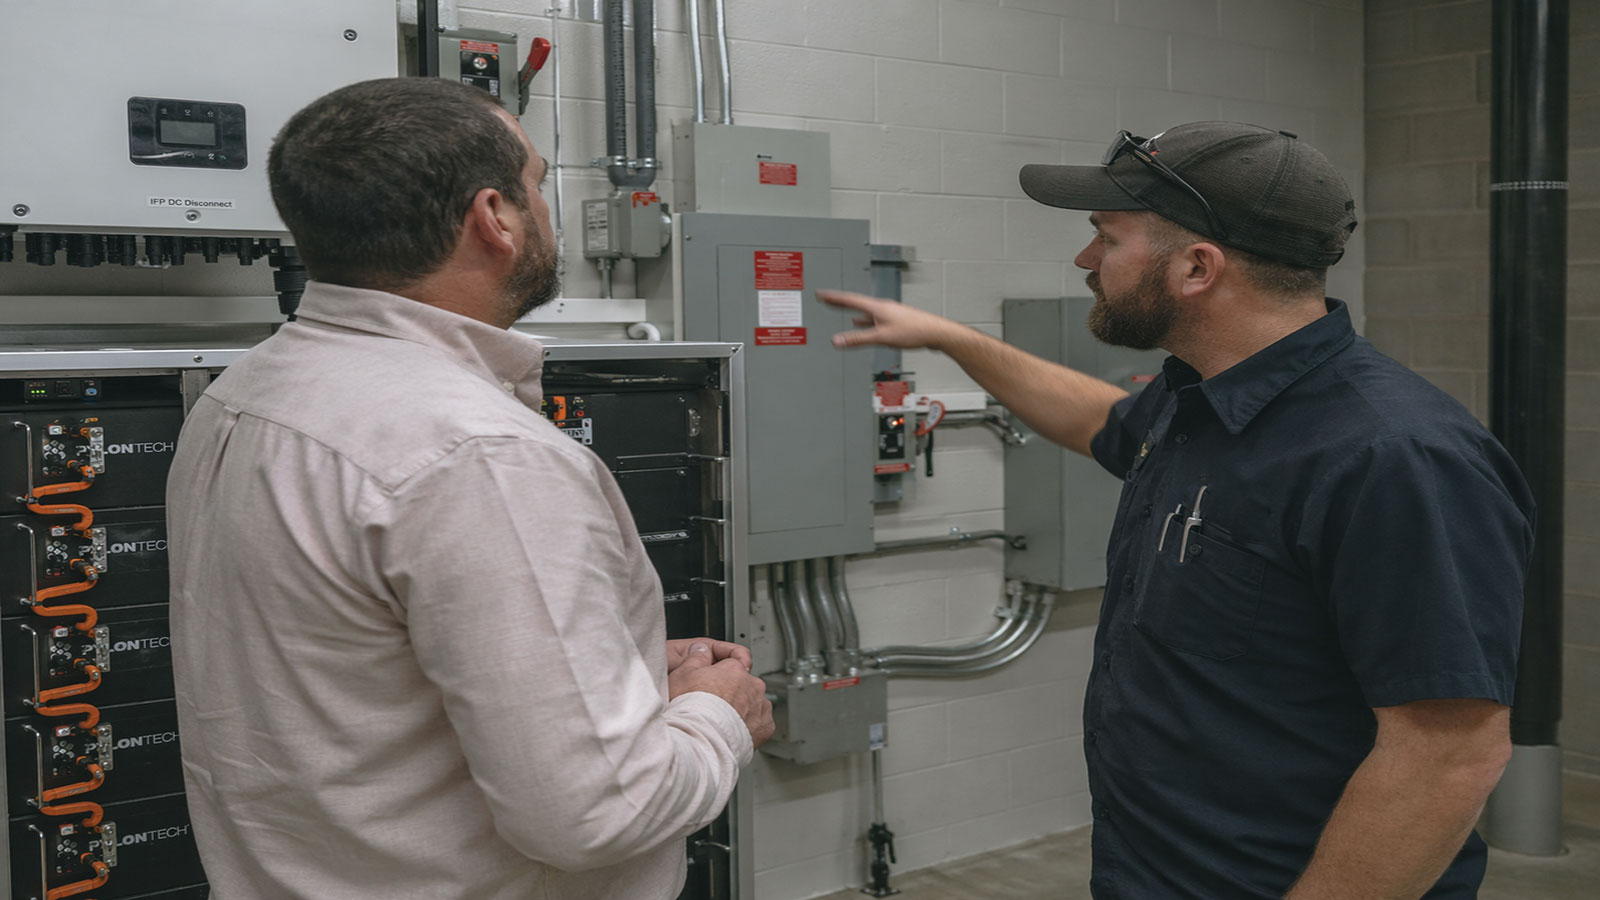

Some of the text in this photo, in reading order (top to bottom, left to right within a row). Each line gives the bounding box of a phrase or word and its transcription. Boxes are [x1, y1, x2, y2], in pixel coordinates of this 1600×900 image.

[168, 198, 182, 206] DC
[185, 199, 232, 207] Disconnect
[75, 441, 174, 456] PONTECH
[84, 731, 180, 754] PONTECH
[88, 826, 188, 852] PONTECH
